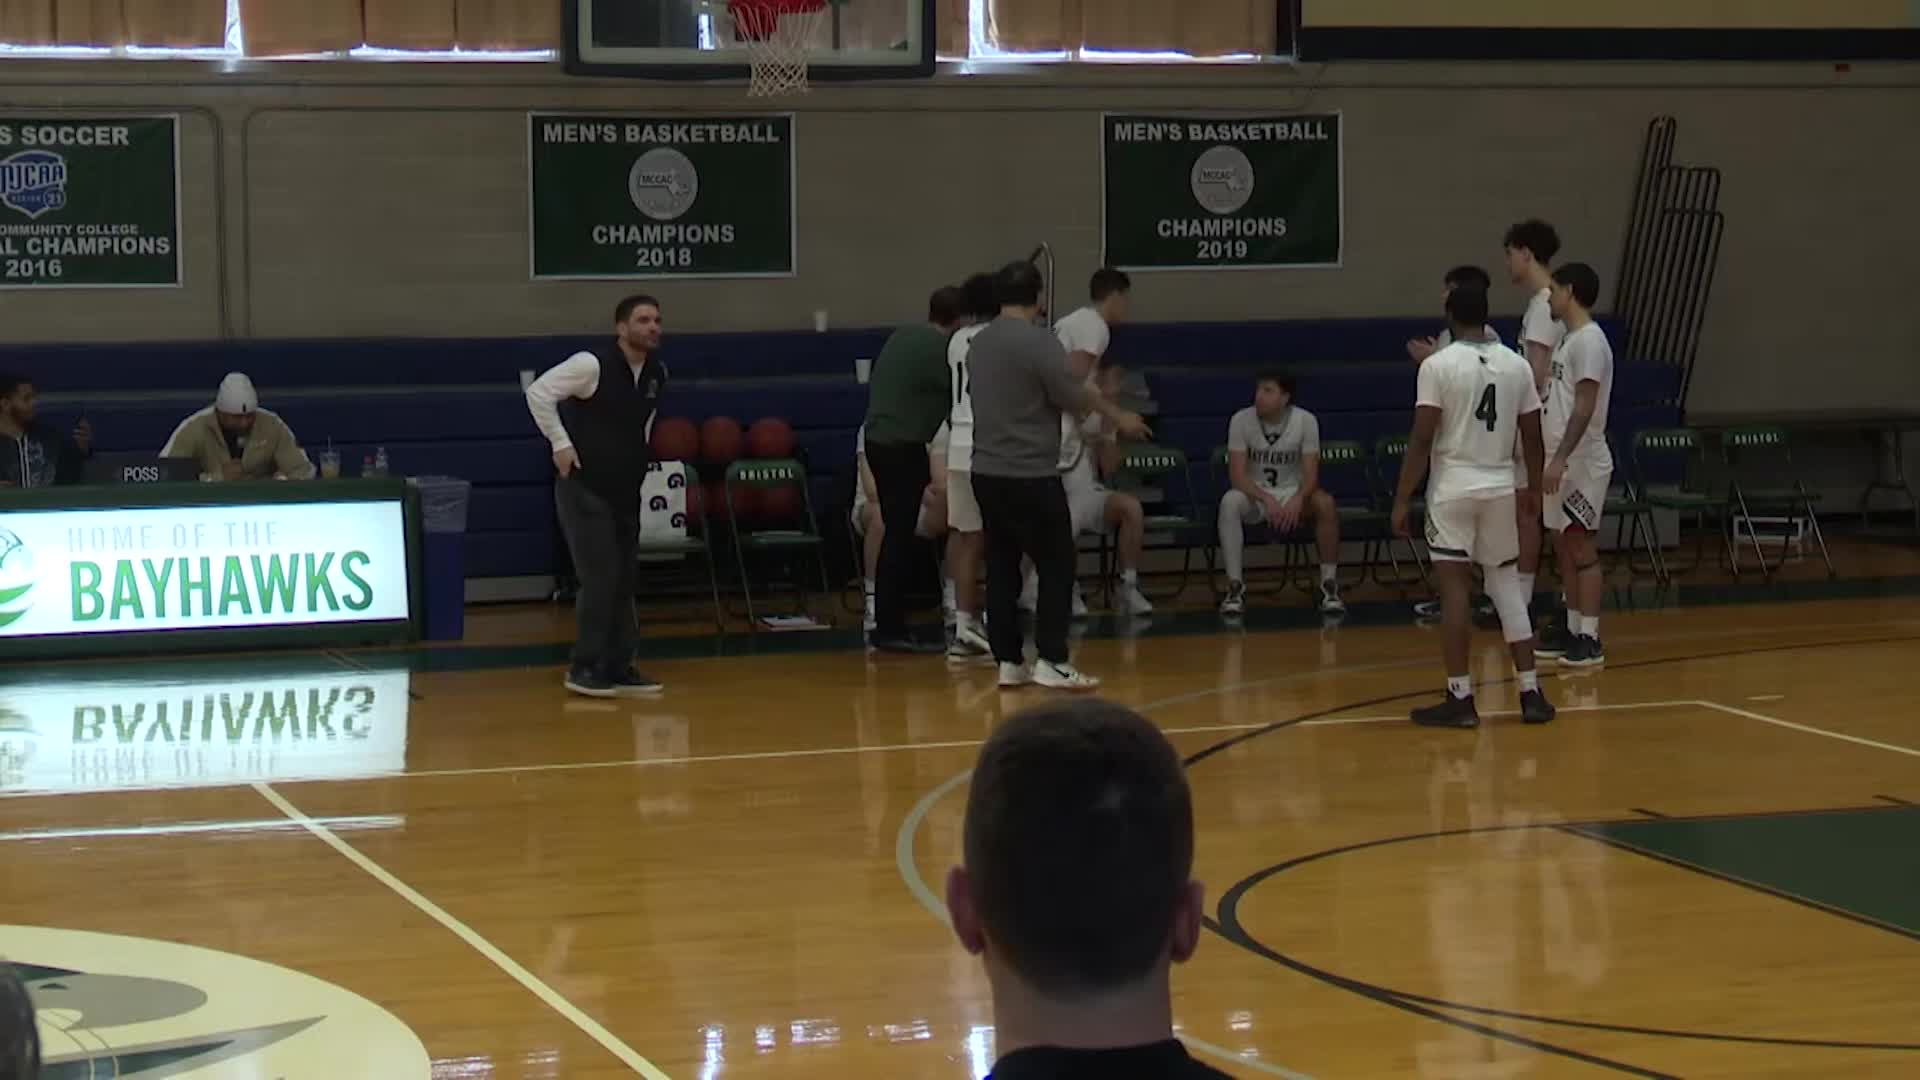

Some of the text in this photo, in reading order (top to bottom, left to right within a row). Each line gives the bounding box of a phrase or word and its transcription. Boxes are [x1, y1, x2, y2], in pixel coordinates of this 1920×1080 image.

[21, 126, 129, 145] SOCCER
[543, 124, 780, 143] MEN'S BASKETBALL
[1114, 122, 1329, 141] MEN'S BASKETBALL
[76, 224, 138, 235] COLLEGE
[592, 225, 735, 244] CHAMPIONS
[1157, 218, 1287, 238] CHAMPIONS
[0, 236, 170, 255] L CHAMPIONS
[1197, 241, 1247, 258] 2019
[636, 248, 692, 267] 2018
[5, 259, 62, 277] 2016
[1475, 383, 1497, 432] 4
[1645, 436, 1693, 447] BRISTOL
[1735, 433, 1779, 445] BRISTOL
[1125, 456, 1176, 468] BRISTOL
[1321, 448, 1355, 459] ISTOL
[123, 466, 159, 482] POSS
[740, 468, 793, 480] BRISTOL
[1263, 468, 1278, 487] 3
[68, 521, 279, 553] HOME OF THE
[70, 550, 374, 622] BAYHAWKS
